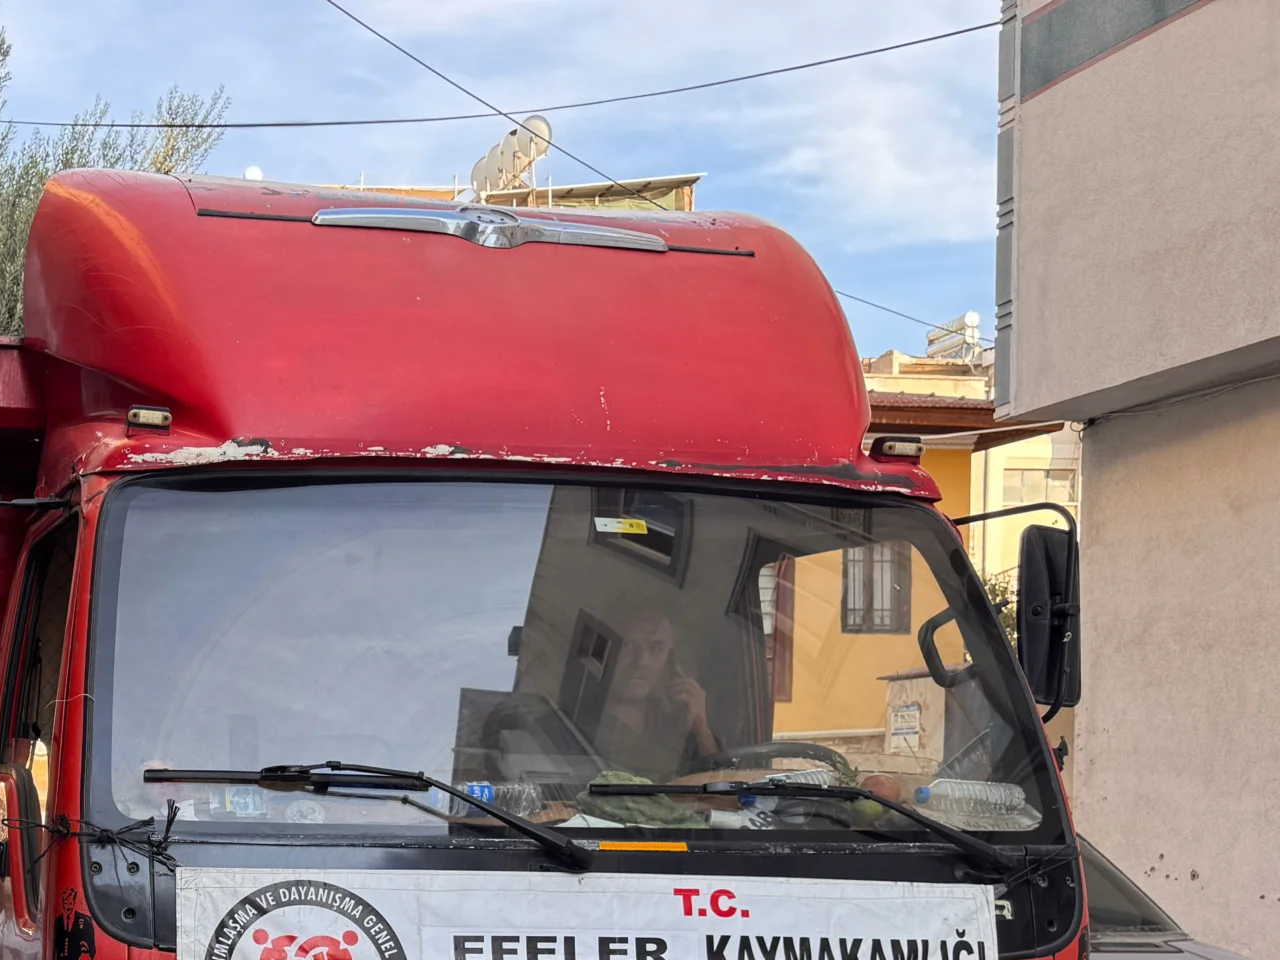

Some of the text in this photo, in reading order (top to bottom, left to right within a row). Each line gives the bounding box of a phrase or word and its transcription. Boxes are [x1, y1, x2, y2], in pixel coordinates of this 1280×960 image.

[258, 891, 277, 909] VE
[279, 886, 362, 919] DAYANIŞMA
[363, 915, 397, 959] GENEL
[673, 888, 750, 918] T.C.
